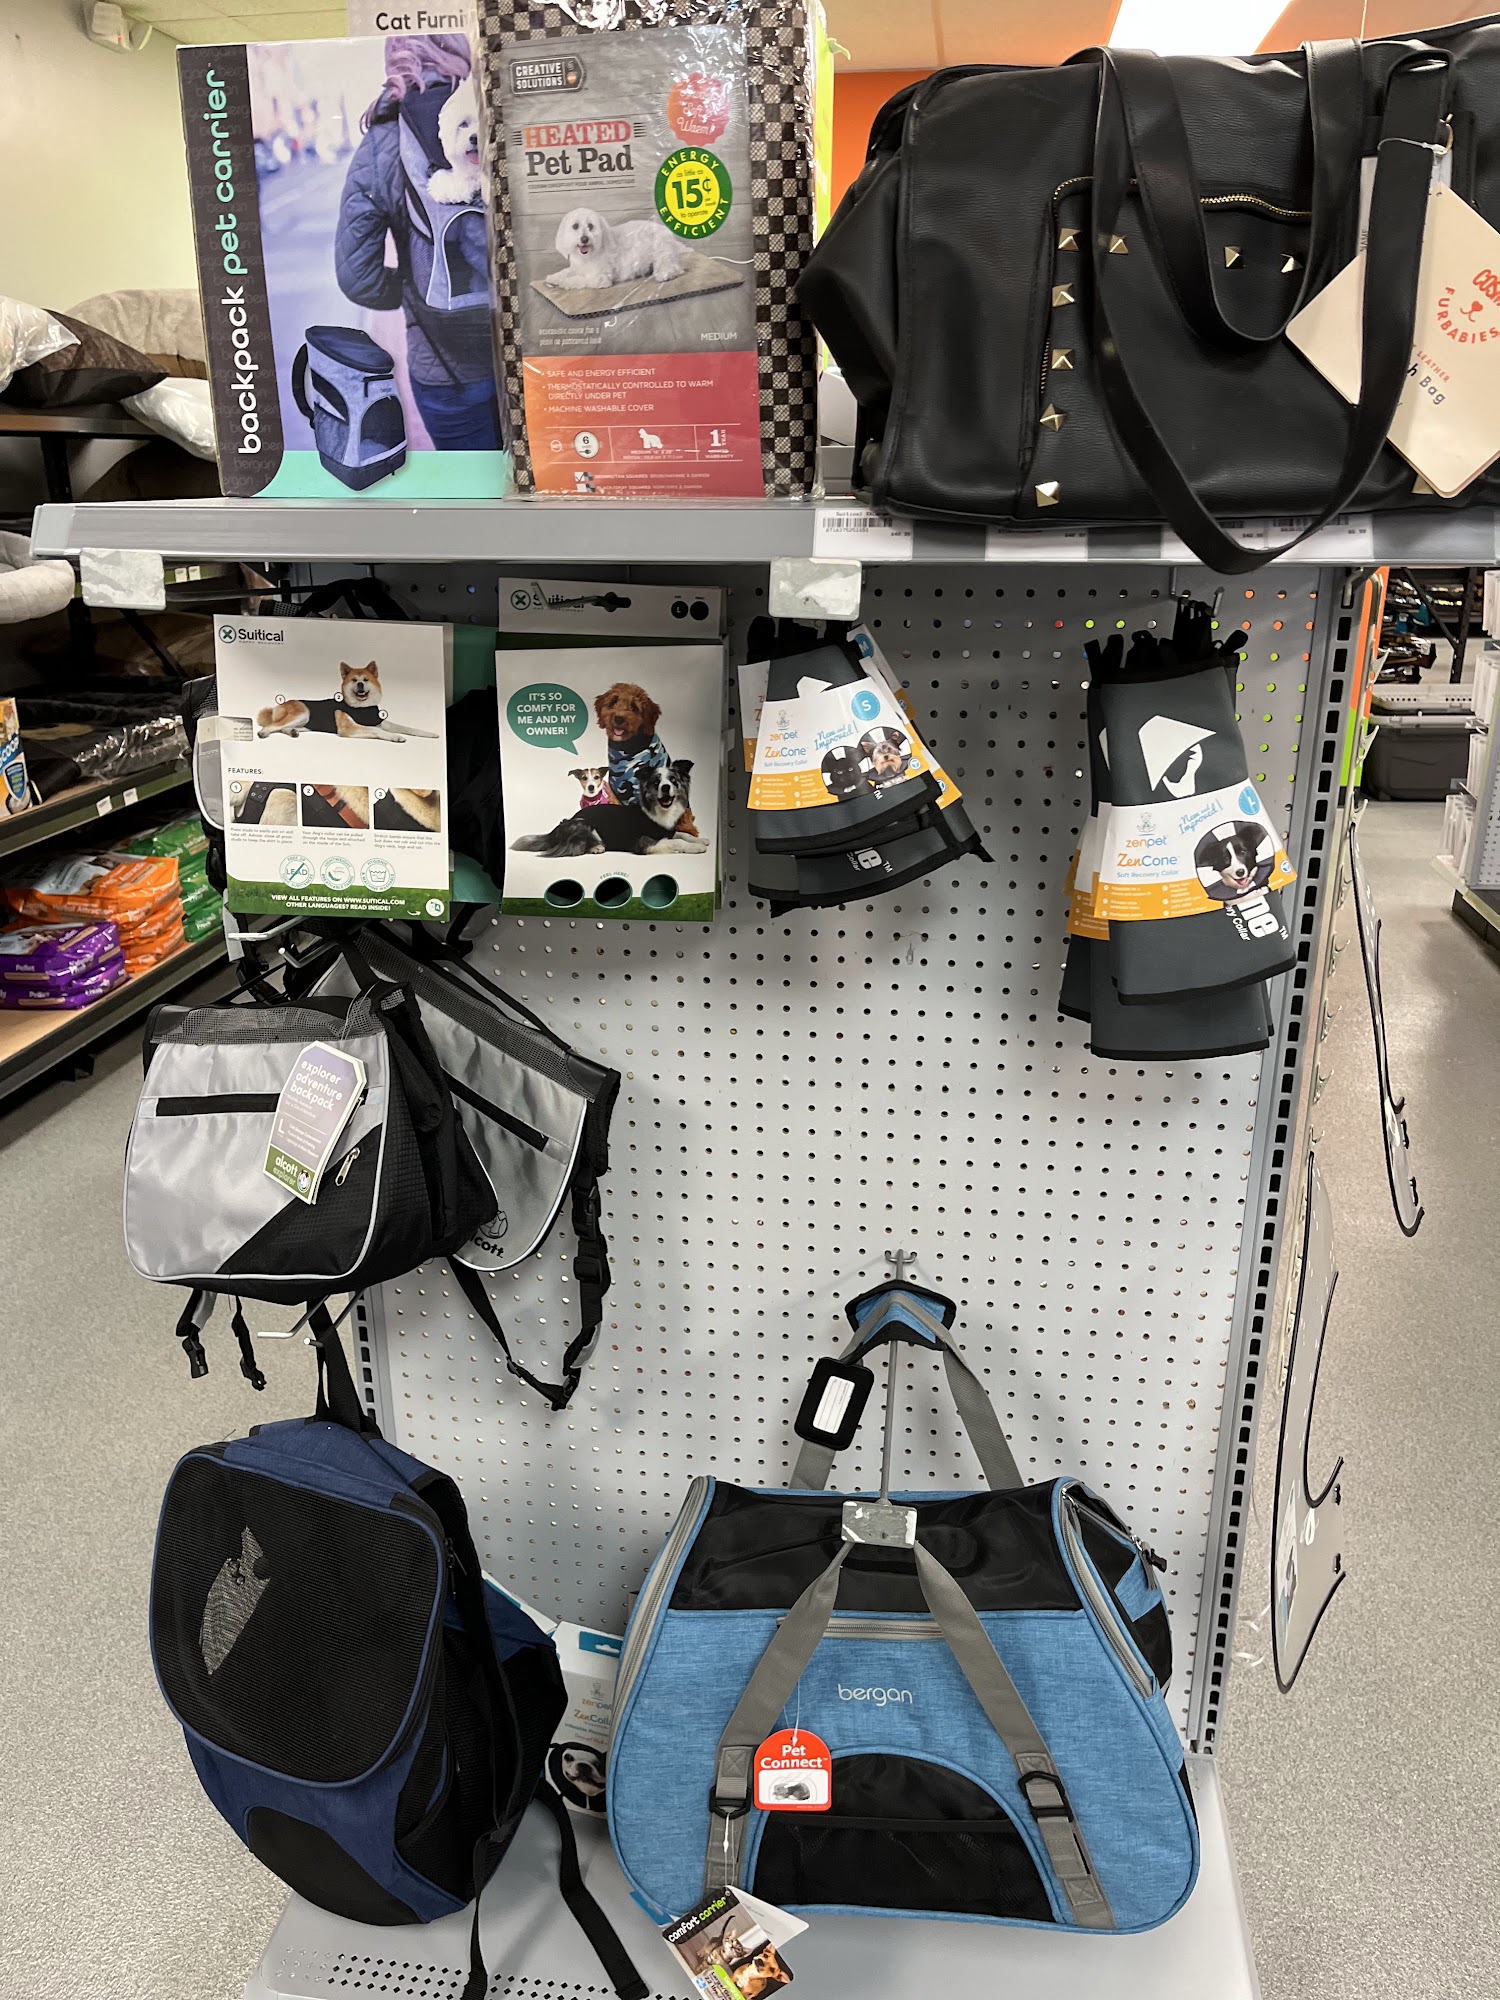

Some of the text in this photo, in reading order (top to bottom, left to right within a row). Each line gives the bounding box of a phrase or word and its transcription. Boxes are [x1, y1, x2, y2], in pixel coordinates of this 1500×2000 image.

[375, 11, 411, 31] Cat
[515, 61, 562, 77] CREATIVE
[516, 77, 563, 90] SOLUTIONS
[523, 120, 632, 149] HEATED
[525, 144, 634, 177] Pet Pad
[661, 150, 720, 177] ENERGY
[659, 197, 729, 237] EFFICIENT
[202, 69, 262, 454] backpack pet carrier
[1437, 286, 1500, 344] FURBABIES
[700, 332, 738, 341] MEDIUM
[547, 370, 566, 378] SAFE
[585, 369, 615, 378] ENERGY
[617, 368, 656, 377] EFFICIENT
[1416, 350, 1450, 383] LEATHER
[547, 379, 714, 391] THERMOSTATICALLY CONTROLLED TO WARM
[1419, 375, 1446, 405] Bag
[548, 391, 627, 400] DIRECTLY UNDER PET
[548, 403, 654, 413] MACHINE WASHABLE COVER
[582, 435, 590, 445] 6
[709, 429, 721, 447] 1
[238, 628, 284, 642] Suitical
[859, 640, 870, 653] M
[528, 692, 563, 701] IT'S SO
[516, 703, 576, 712] COMFY FOR
[861, 699, 872, 712] S
[517, 715, 576, 724] ME AND MY
[526, 726, 568, 735] OWNER!
[769, 729, 799, 742] zenpet
[817, 731, 837, 742] New
[764, 746, 807, 759] ZenCone
[774, 759, 795, 768] Recovery
[227, 767, 264, 775] FEATURES:
[1181, 810, 1202, 824] New
[1125, 836, 1167, 849] zenpet
[1117, 853, 1178, 867] ZenCone
[286, 868, 308, 876] LEAD
[1130, 871, 1161, 879] Recovery
[1161, 869, 1179, 877] Collar
[301, 895, 332, 903] FEATURES
[344, 897, 406, 906] WWW.SUITICAL.COM
[307, 902, 349, 910] LANGUAGES?
[1232, 917, 1251, 941] Collar
[301, 1059, 342, 1085] explorer
[295, 1071, 343, 1101] adventure
[289, 1080, 335, 1112] backpack
[277, 1118, 285, 1135] L
[275, 1155, 298, 1178] alcott
[272, 1167, 296, 1187] explorer
[837, 1683, 913, 1707] bergan
[781, 1744, 807, 1757] Pet
[667, 1895, 727, 1943] comfort carrier
